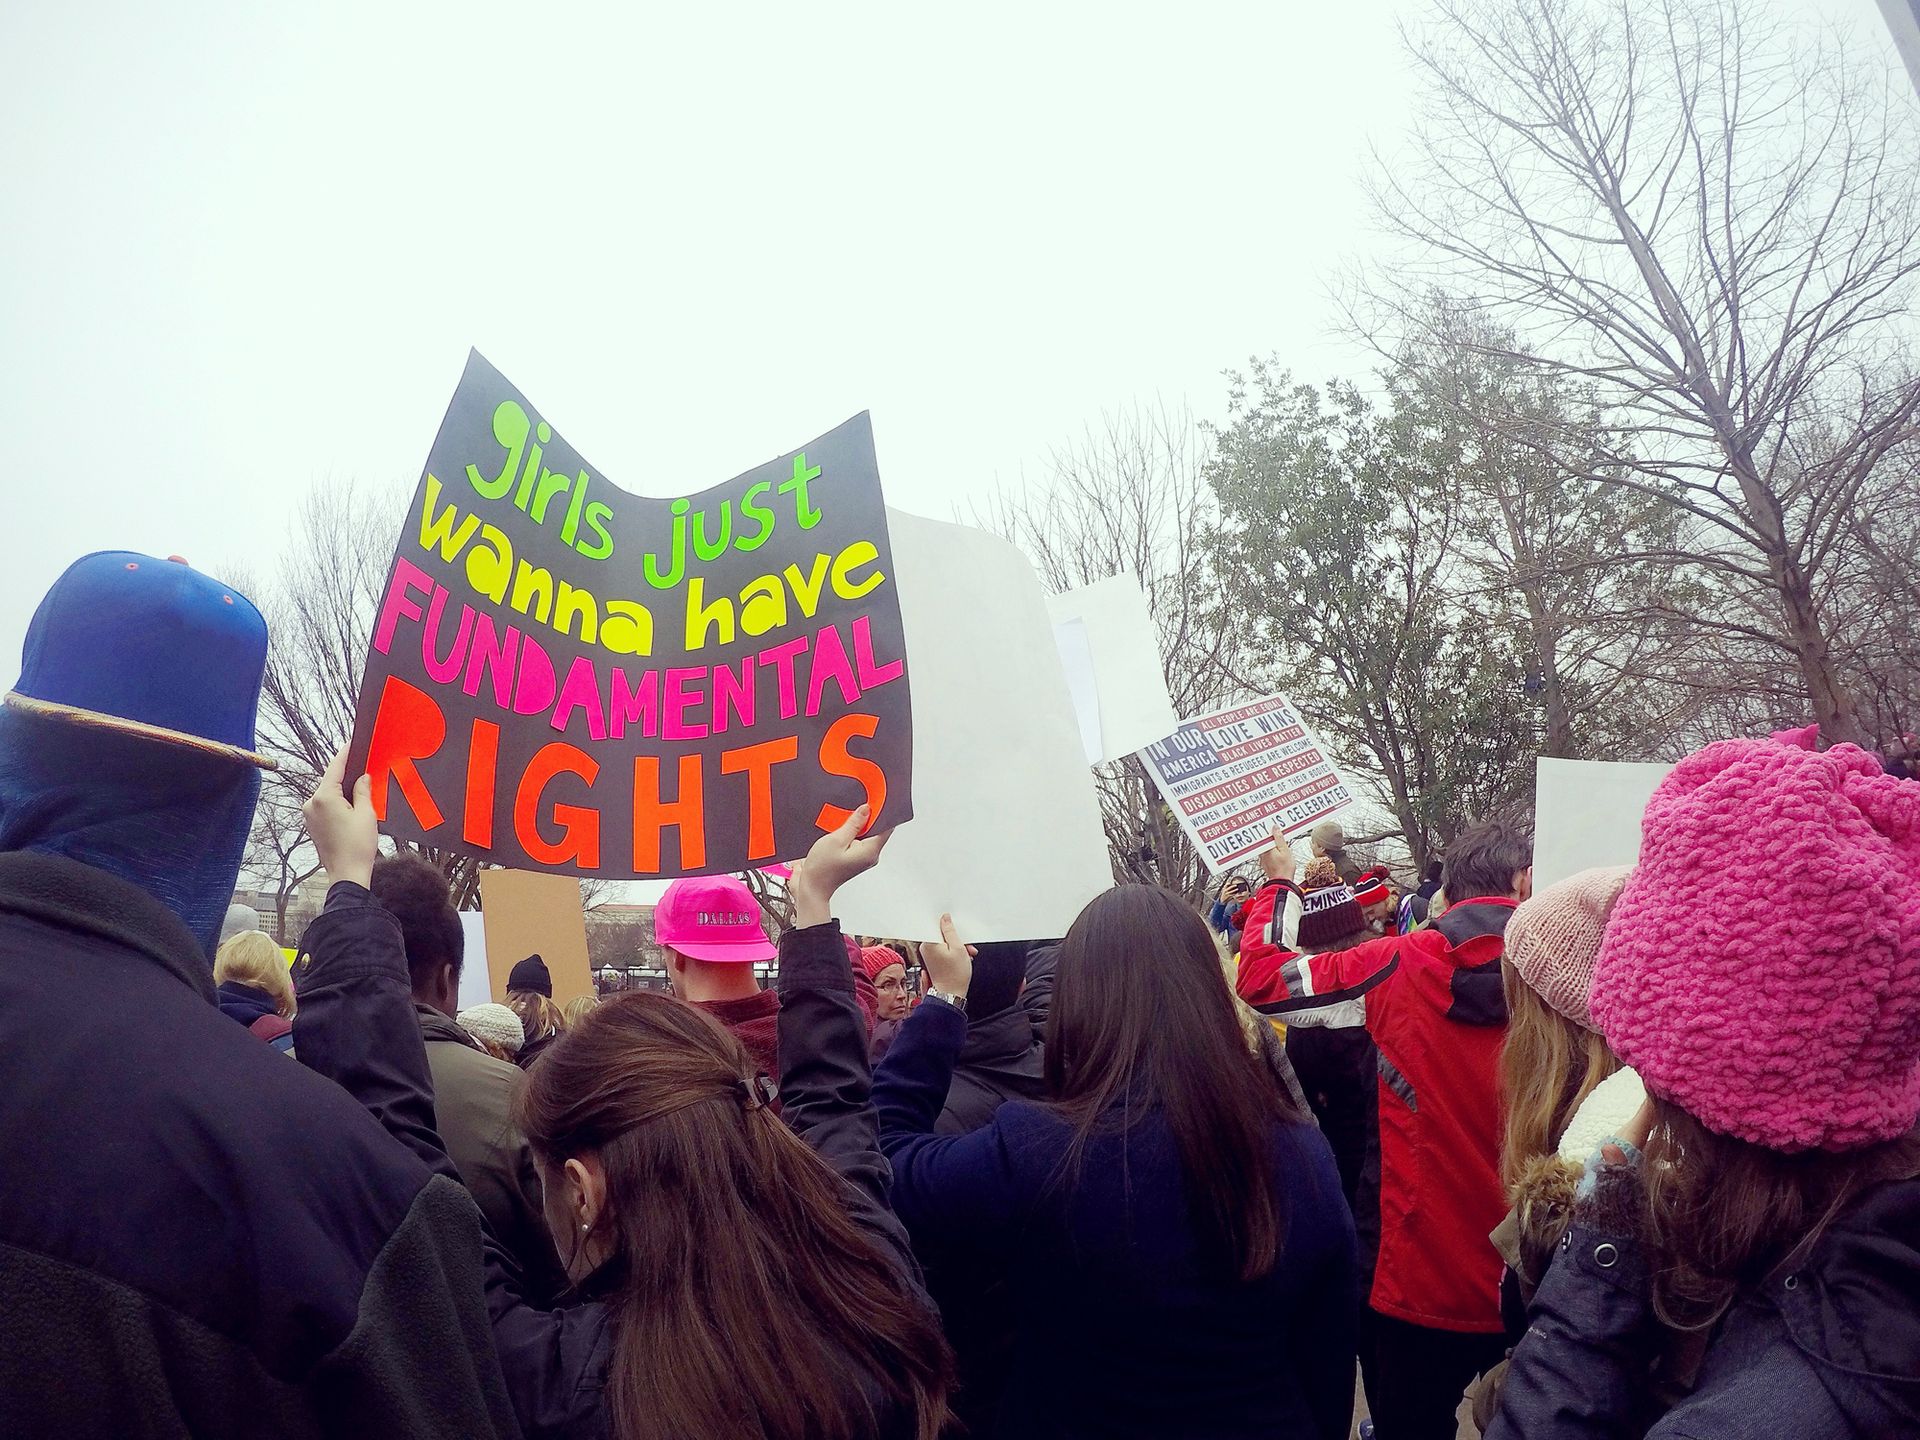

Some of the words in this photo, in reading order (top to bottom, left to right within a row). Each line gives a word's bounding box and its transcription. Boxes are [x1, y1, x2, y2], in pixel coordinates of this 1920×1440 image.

[465, 400, 614, 560] girls
[644, 452, 822, 589] just
[418, 473, 653, 656] wanna
[686, 541, 886, 651] have
[374, 556, 904, 741] FUNDAMENTAL
[1149, 740, 1171, 760] IN
[1171, 728, 1208, 752] OUR
[1201, 719, 1216, 730] ALL
[1217, 710, 1244, 726] PEOPLE
[1245, 706, 1261, 717] ARE
[1261, 699, 1282, 712] EQUAL
[1208, 723, 1253, 749] LOVE
[1254, 708, 1296, 733] WINS
[1221, 747, 1248, 761] BLACK
[1249, 738, 1272, 752] LIVES
[1272, 726, 1303, 742] MATTER
[366, 675, 887, 874] RIGHTS
[1161, 749, 1219, 779] AMERICA
[1170, 771, 1223, 797] IMMIGRANTS
[1223, 769, 1230, 778] &
[1230, 755, 1267, 776] REFUGEES
[1267, 749, 1281, 761] ARE
[1280, 738, 1313, 756] WELCOME
[1184, 779, 1250, 813] DISABILITIES
[1252, 772, 1272, 787] ARE
[1272, 751, 1320, 777] RESPECTED
[1190, 811, 1221, 827] WOMEN
[1223, 802, 1238, 815] ARE
[1240, 798, 1249, 808] IN
[1250, 786, 1277, 803] CHARGE
[1277, 782, 1287, 791] OF
[1289, 773, 1307, 787] THEIR
[1308, 763, 1331, 778] BODIES
[1202, 822, 1230, 839] PEOPLE
[1238, 809, 1263, 824] PLANET
[1264, 801, 1278, 813] ARE
[1277, 792, 1301, 807] VALUED
[1300, 785, 1316, 796] OVER
[1316, 775, 1336, 789] PROFIT
[1207, 822, 1269, 859] DIVERSITY
[1287, 785, 1349, 822] CELEBRATED
[698, 911, 751, 925] DALLAS
[1303, 888, 1352, 911] EMINIST
